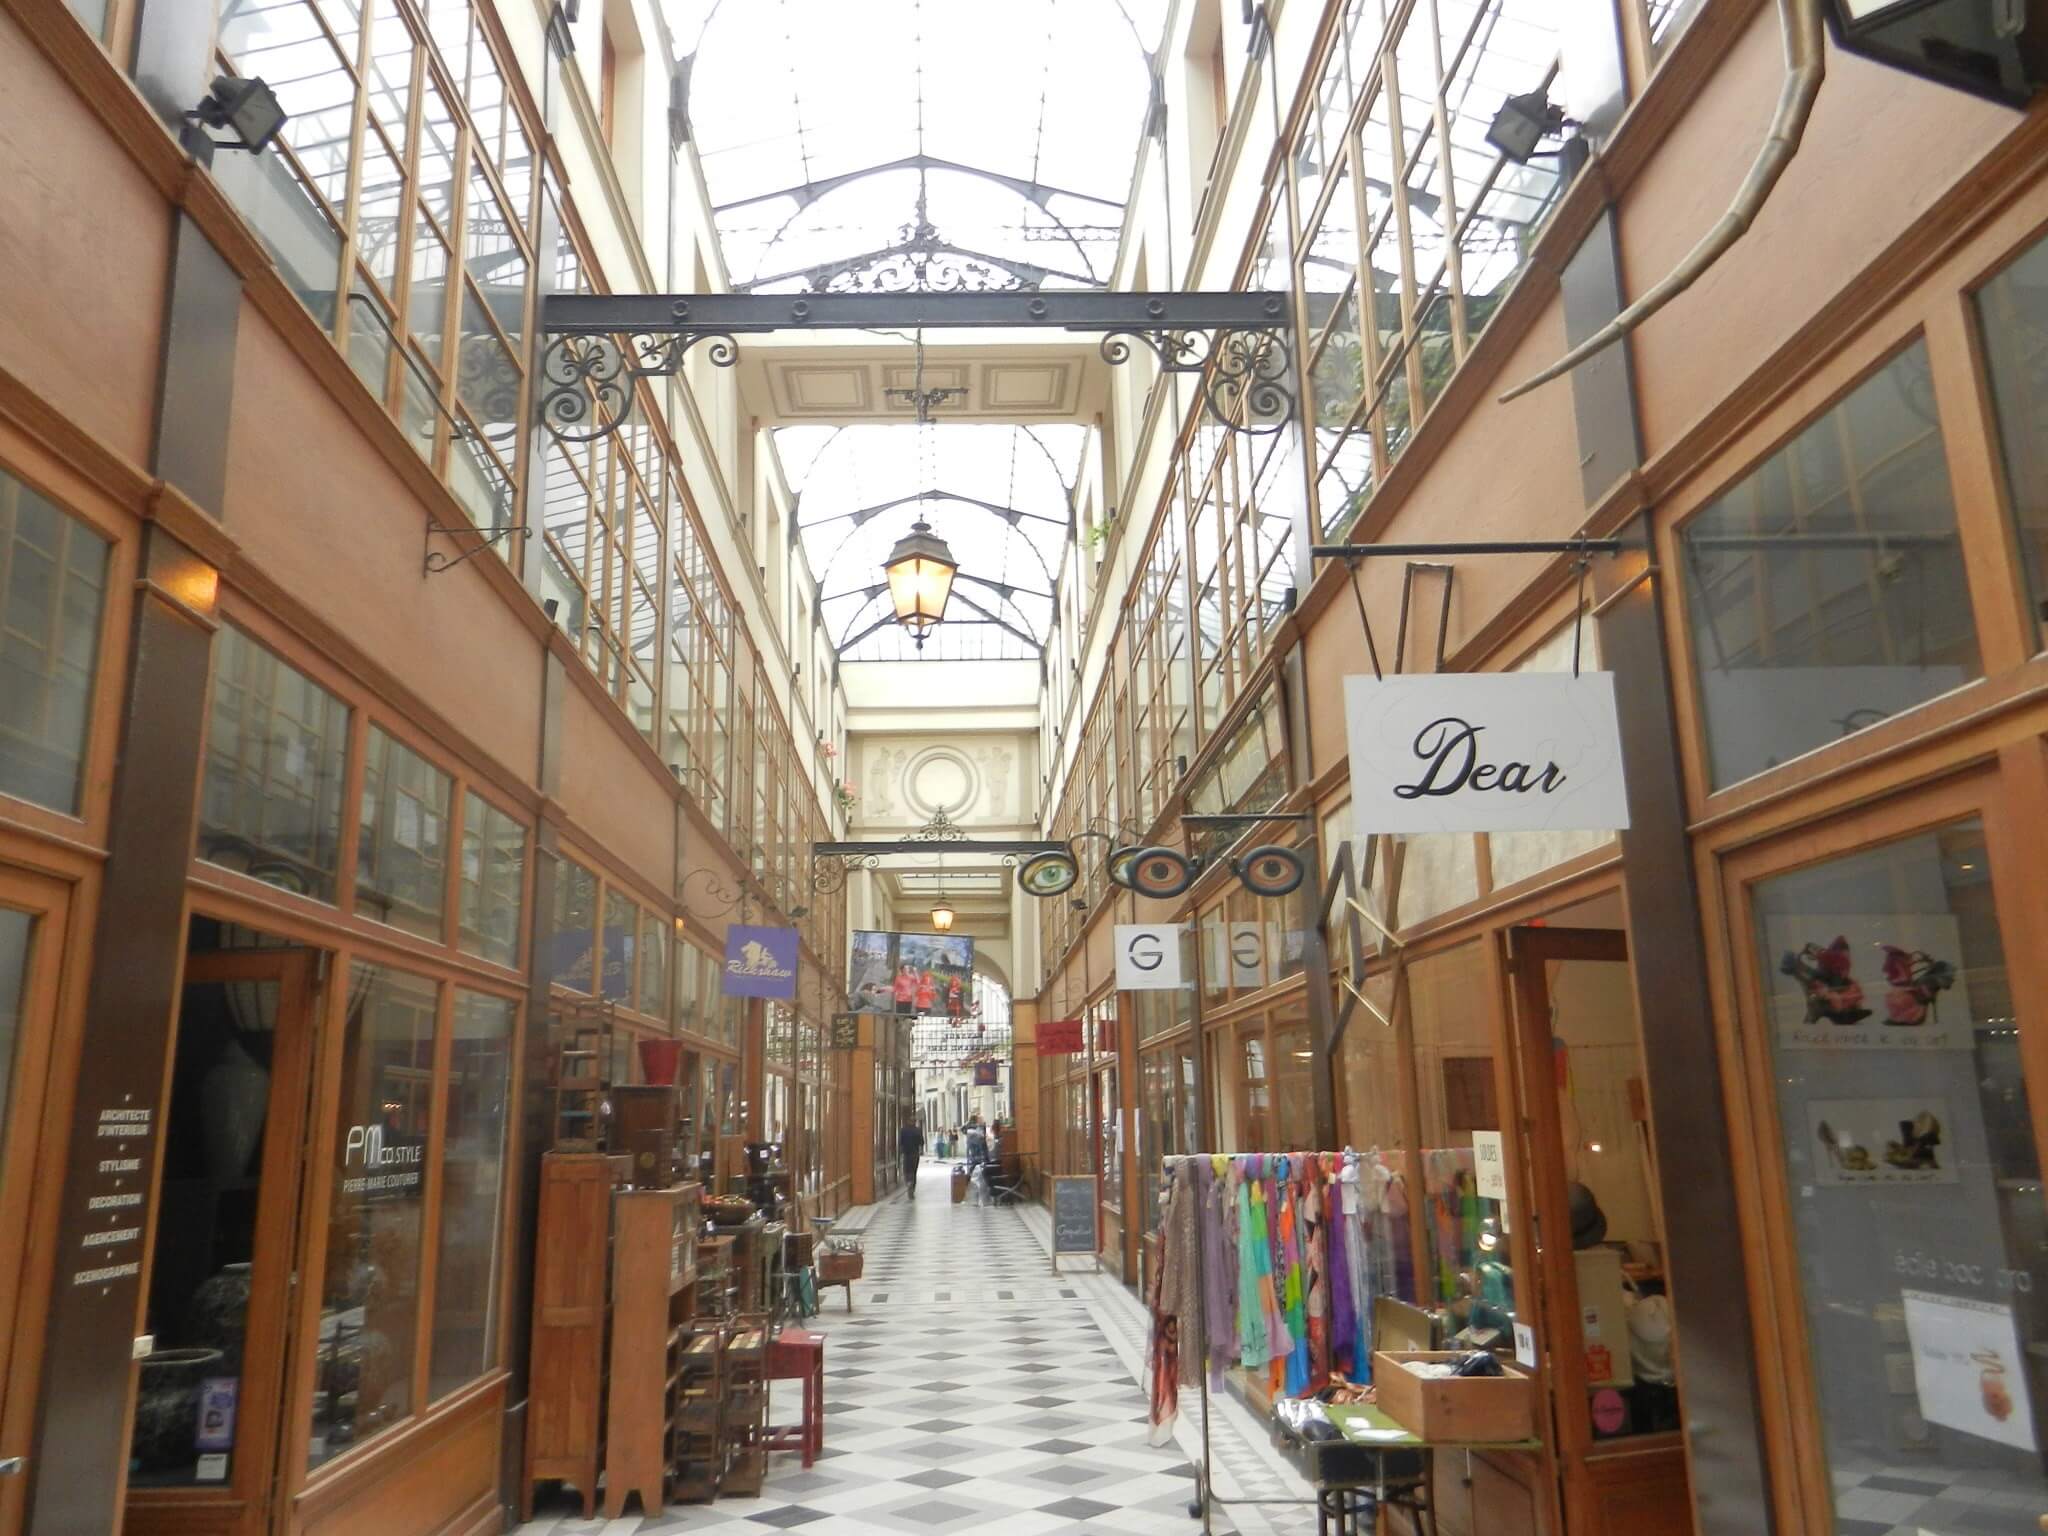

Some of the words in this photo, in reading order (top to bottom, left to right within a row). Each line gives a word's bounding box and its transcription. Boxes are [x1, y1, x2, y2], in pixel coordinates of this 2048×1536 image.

[1393, 717, 1566, 799] Dear
[1128, 933, 1163, 971] G
[99, 1109, 152, 1121] ARCHITECTE
[99, 1158, 141, 1172] STYLISME
[88, 1193, 143, 1210] DECORATION
[82, 1227, 141, 1247] AGENCEMENT
